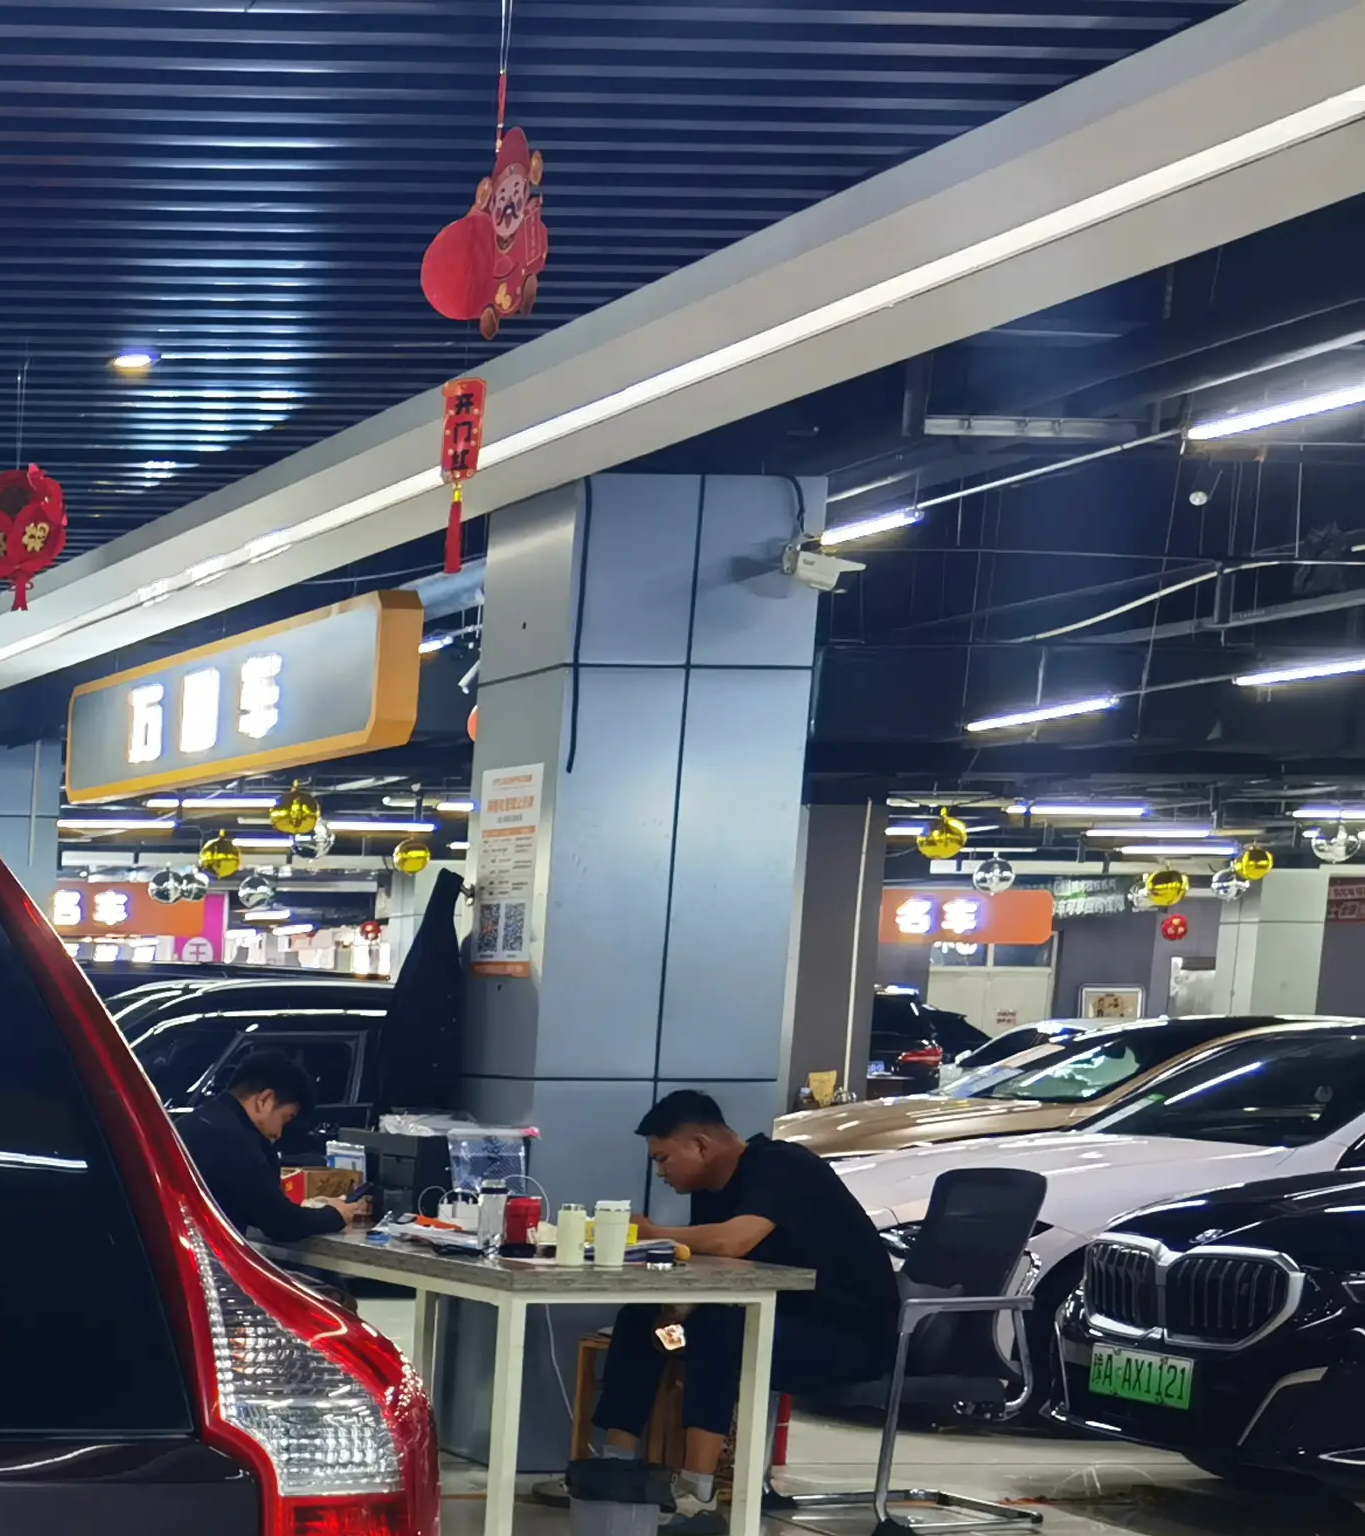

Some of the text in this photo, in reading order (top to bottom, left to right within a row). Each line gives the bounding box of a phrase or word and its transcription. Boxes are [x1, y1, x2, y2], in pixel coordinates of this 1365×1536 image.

[449, 393, 475, 472] 开门红
[1122, 1357, 1186, 1400] AX1121
